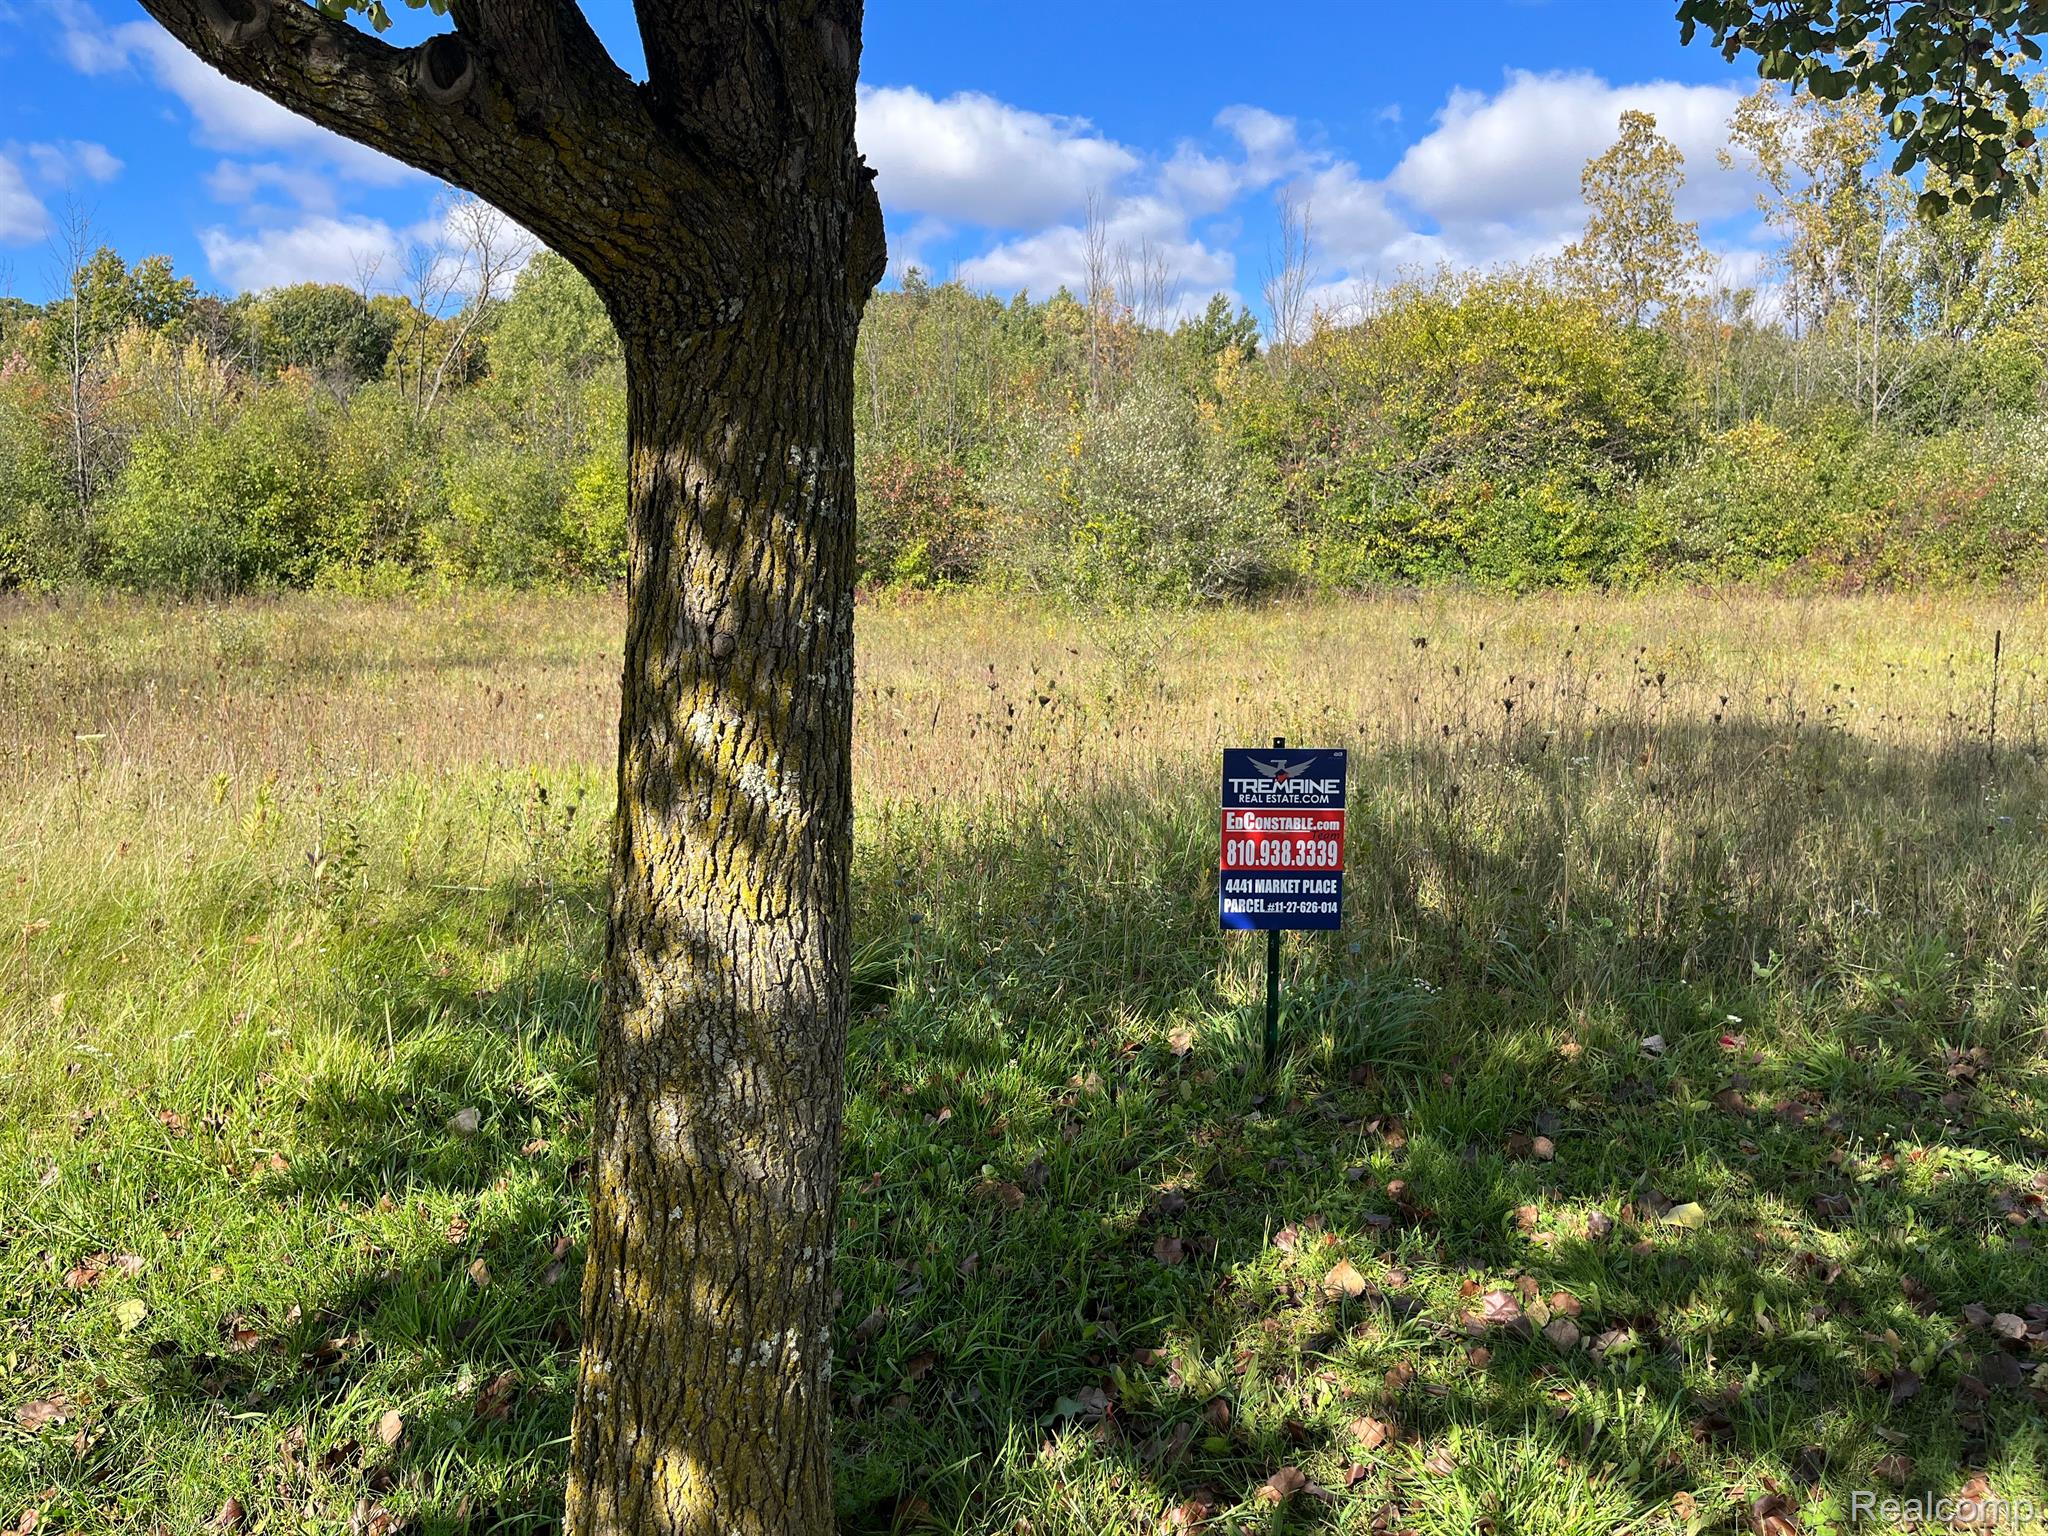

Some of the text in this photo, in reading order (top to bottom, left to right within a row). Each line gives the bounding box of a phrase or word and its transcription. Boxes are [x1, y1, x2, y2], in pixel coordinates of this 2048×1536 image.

[1228, 778, 1340, 794] TREMAINE
[1239, 795, 1330, 804] REAL ESTATE.COM
[1226, 839, 1338, 867] 810.938.3339
[1225, 879, 1337, 894] 4441 MARKET PLACE
[1223, 898, 1338, 914] PARCEL #11-27-626-014
